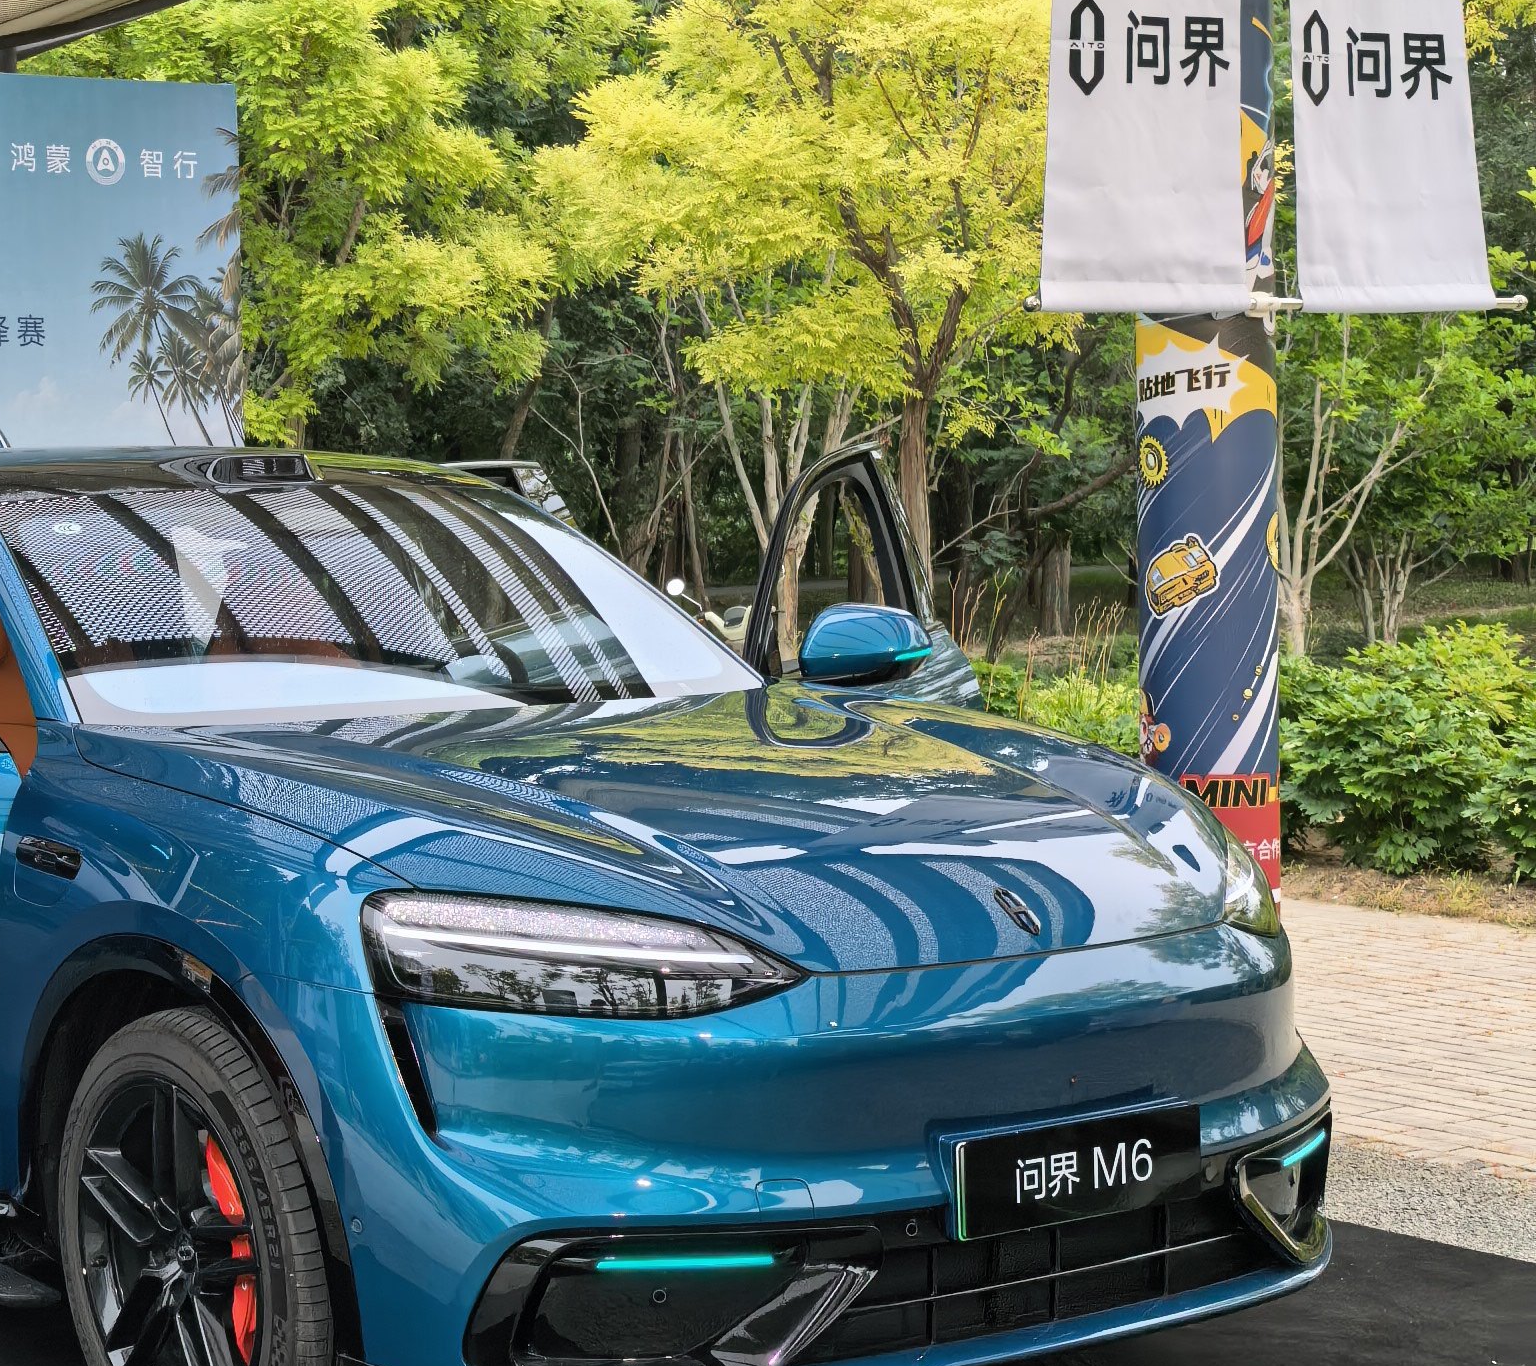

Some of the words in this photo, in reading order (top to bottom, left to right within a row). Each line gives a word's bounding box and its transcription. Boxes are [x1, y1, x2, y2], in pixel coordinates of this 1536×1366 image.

[1126, 9, 1231, 89] 问界
[1345, 26, 1454, 101] 问界
[10, 142, 72, 175] 鸿蒙
[139, 148, 198, 179] 智行
[1138, 362, 1231, 403] 贴地飞行
[1183, 778, 1269, 808] MINI
[1015, 1150, 1081, 1204] 问界
[1092, 1138, 1154, 1189] M6
